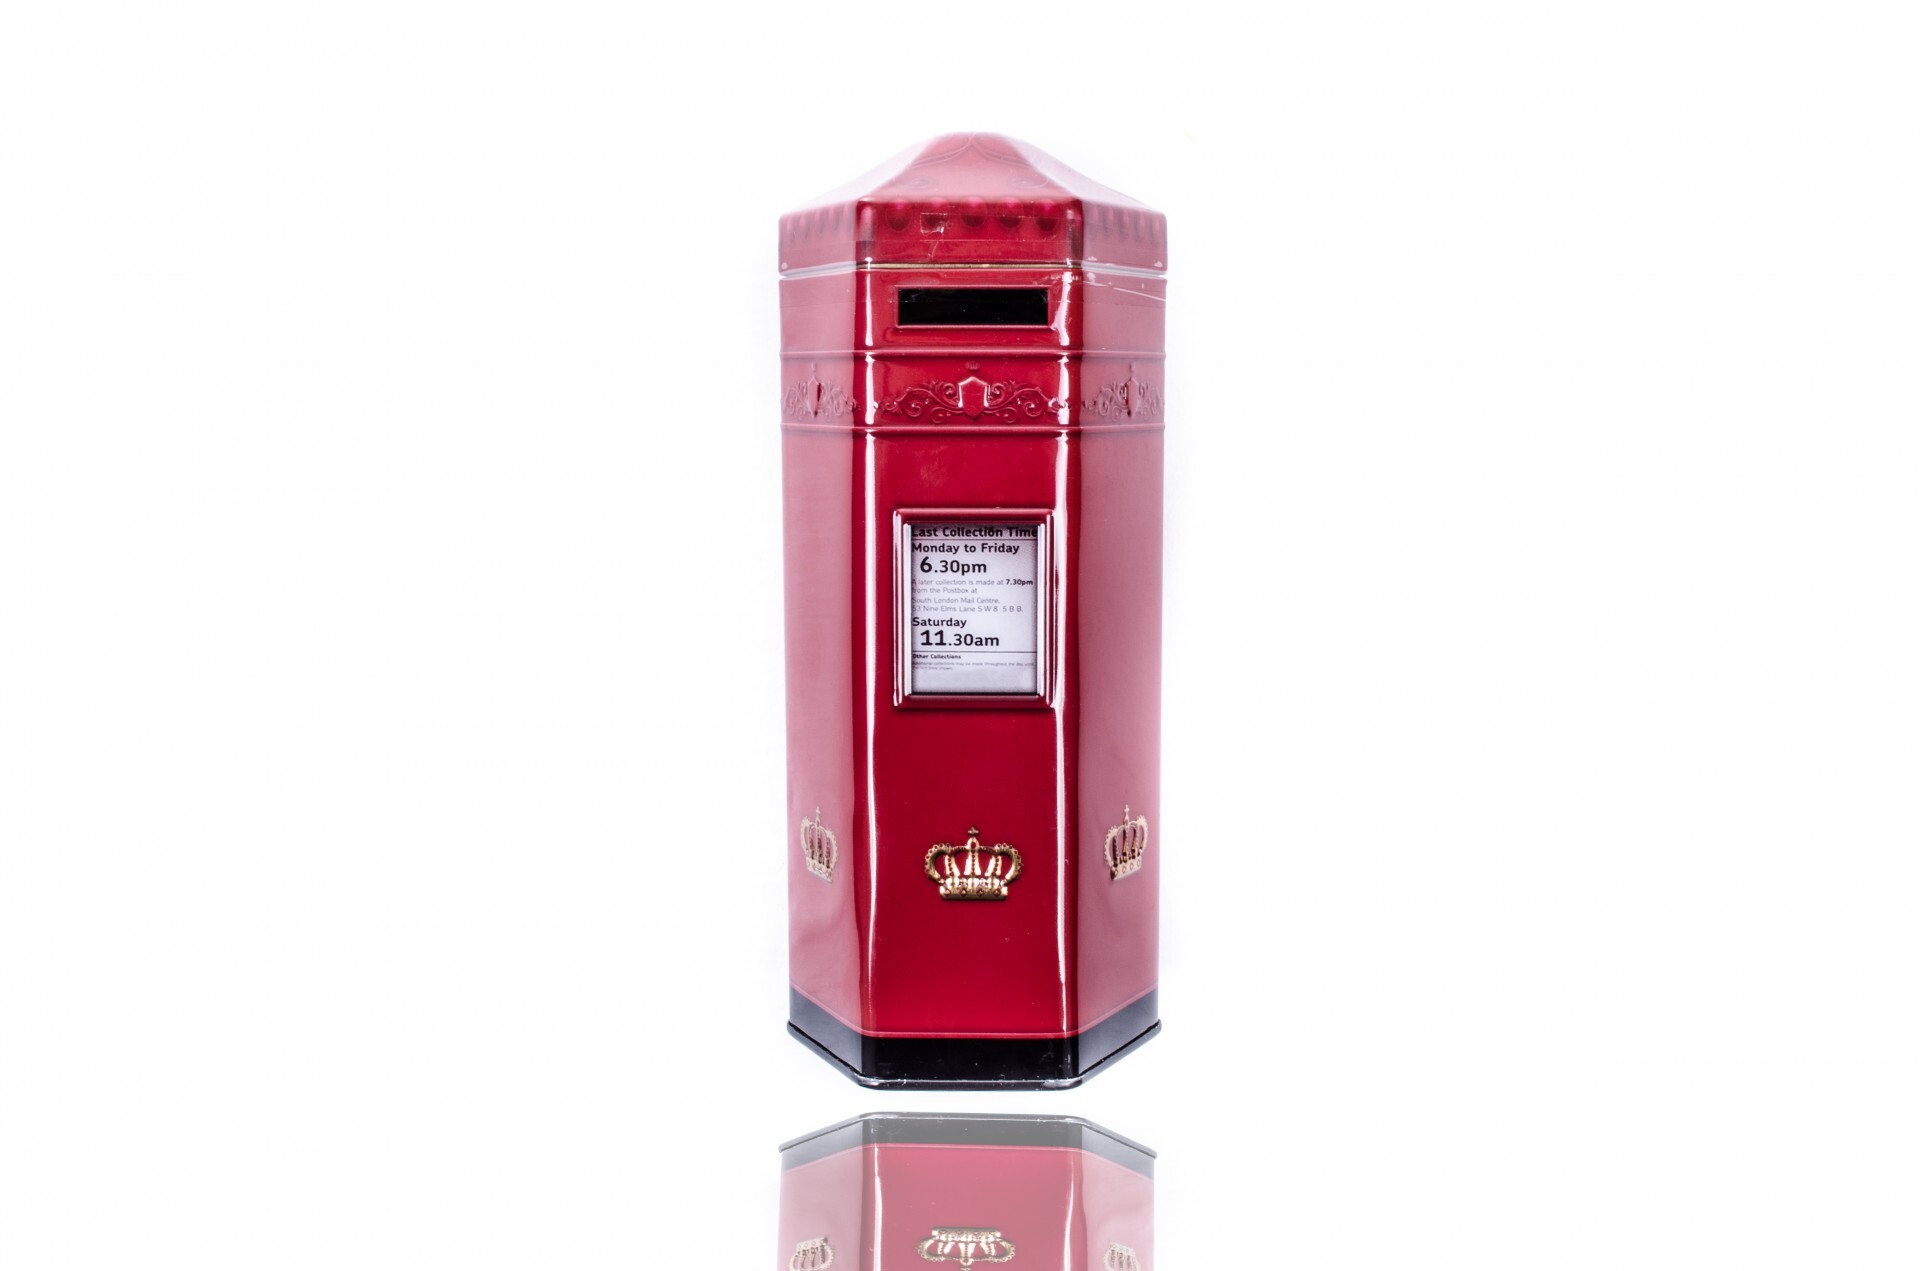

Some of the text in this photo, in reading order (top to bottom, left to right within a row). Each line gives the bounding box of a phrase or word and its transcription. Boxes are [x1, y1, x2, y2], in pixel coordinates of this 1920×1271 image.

[911, 526, 938, 537] Last
[942, 526, 1003, 537] Collection
[911, 543, 1020, 555] Monday to Friday
[920, 556, 987, 576] 6.30pm
[1005, 579, 1034, 587] 7.30pm
[912, 617, 967, 629] Saturday
[920, 629, 1000, 647] 11.30am
